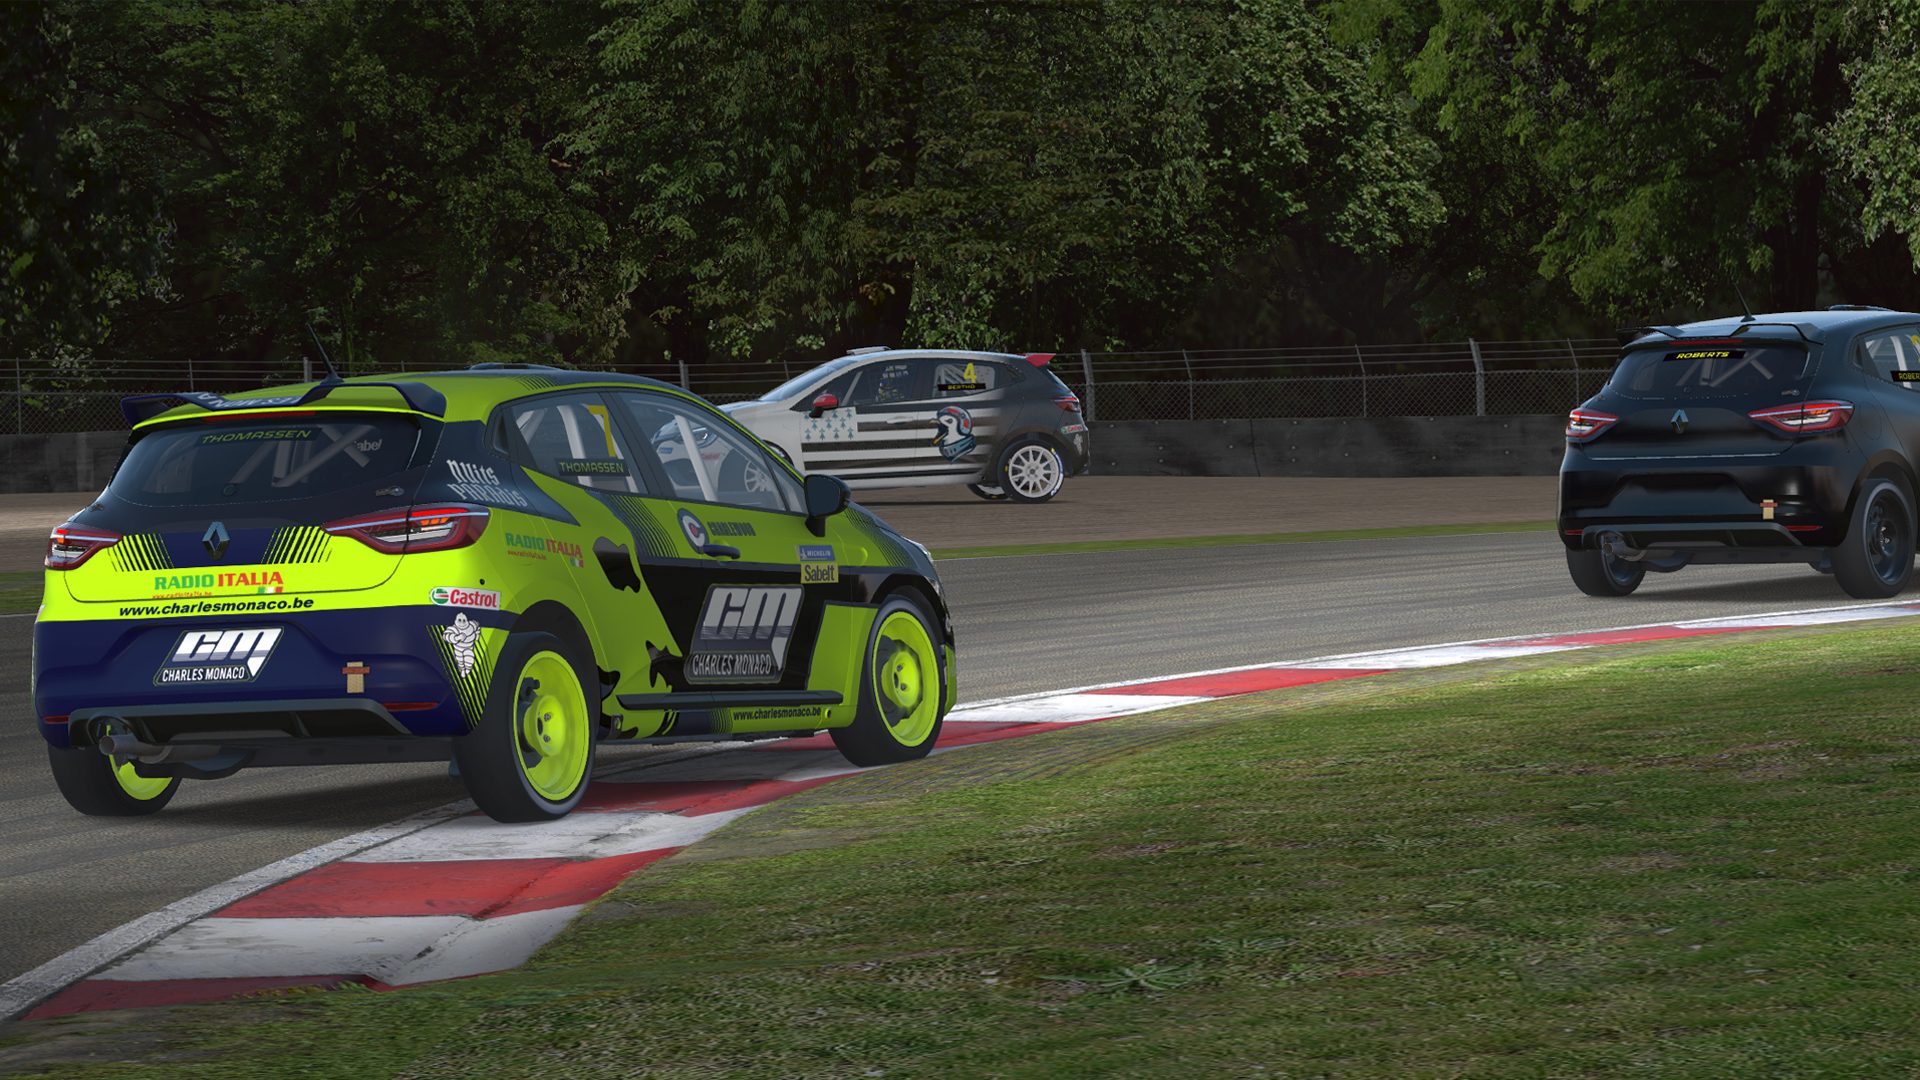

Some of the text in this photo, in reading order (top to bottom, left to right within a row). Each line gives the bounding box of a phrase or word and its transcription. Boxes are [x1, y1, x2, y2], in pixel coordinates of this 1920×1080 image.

[1676, 351, 1730, 360] ROBERTS
[963, 362, 977, 384] 4
[202, 429, 312, 445] THOMASSEN
[586, 404, 617, 458] 7
[560, 462, 625, 474] THOMASSEN
[505, 532, 584, 559] RADIO ITALIA
[154, 571, 284, 590] RADIO ITALIA
[804, 564, 835, 582] Sabelt
[119, 598, 315, 617] www.charlesmonaco.be
[450, 588, 497, 608] Castrol
[692, 653, 772, 676] CHARLES MONACO
[162, 666, 245, 683] CHARLES MONACO
[733, 706, 822, 721] www.charlesmonaco.be
